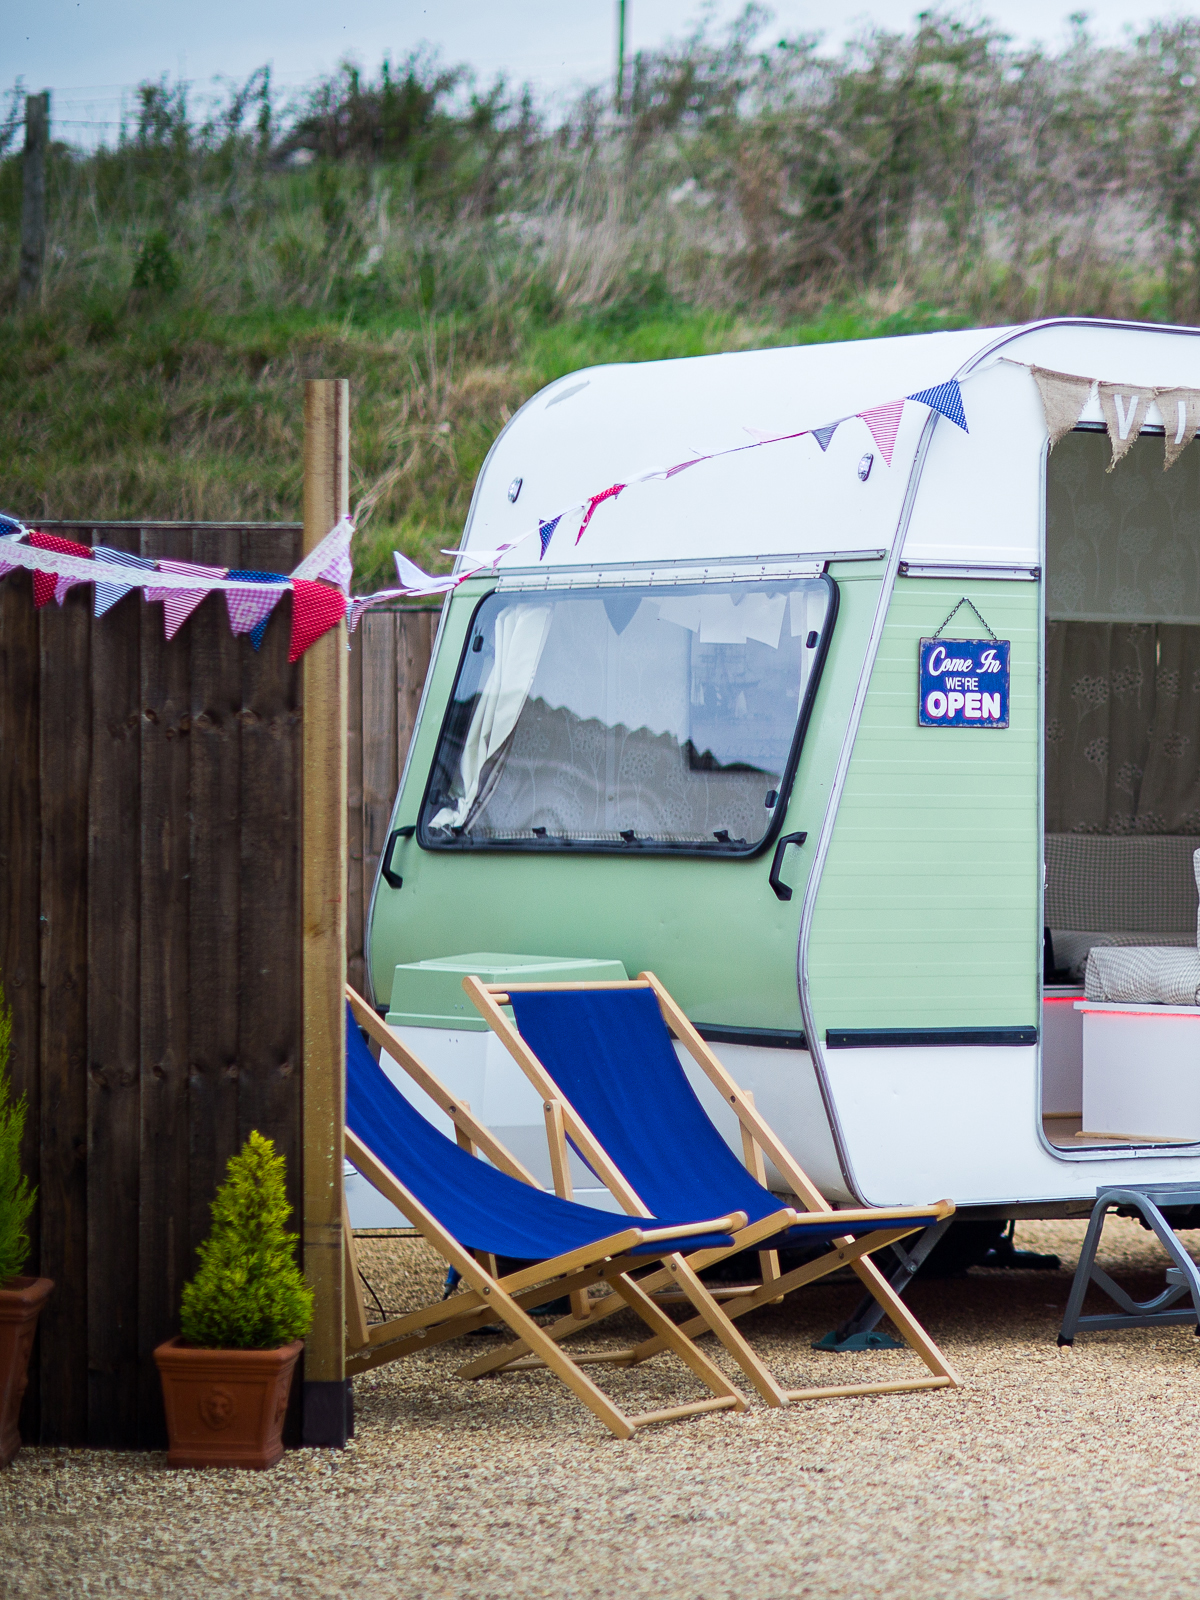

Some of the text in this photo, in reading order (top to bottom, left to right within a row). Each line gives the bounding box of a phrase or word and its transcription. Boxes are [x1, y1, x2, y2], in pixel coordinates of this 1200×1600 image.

[928, 646, 1002, 677] Come In
[945, 677, 979, 690] WE'RE
[926, 691, 1001, 719] OPEN
